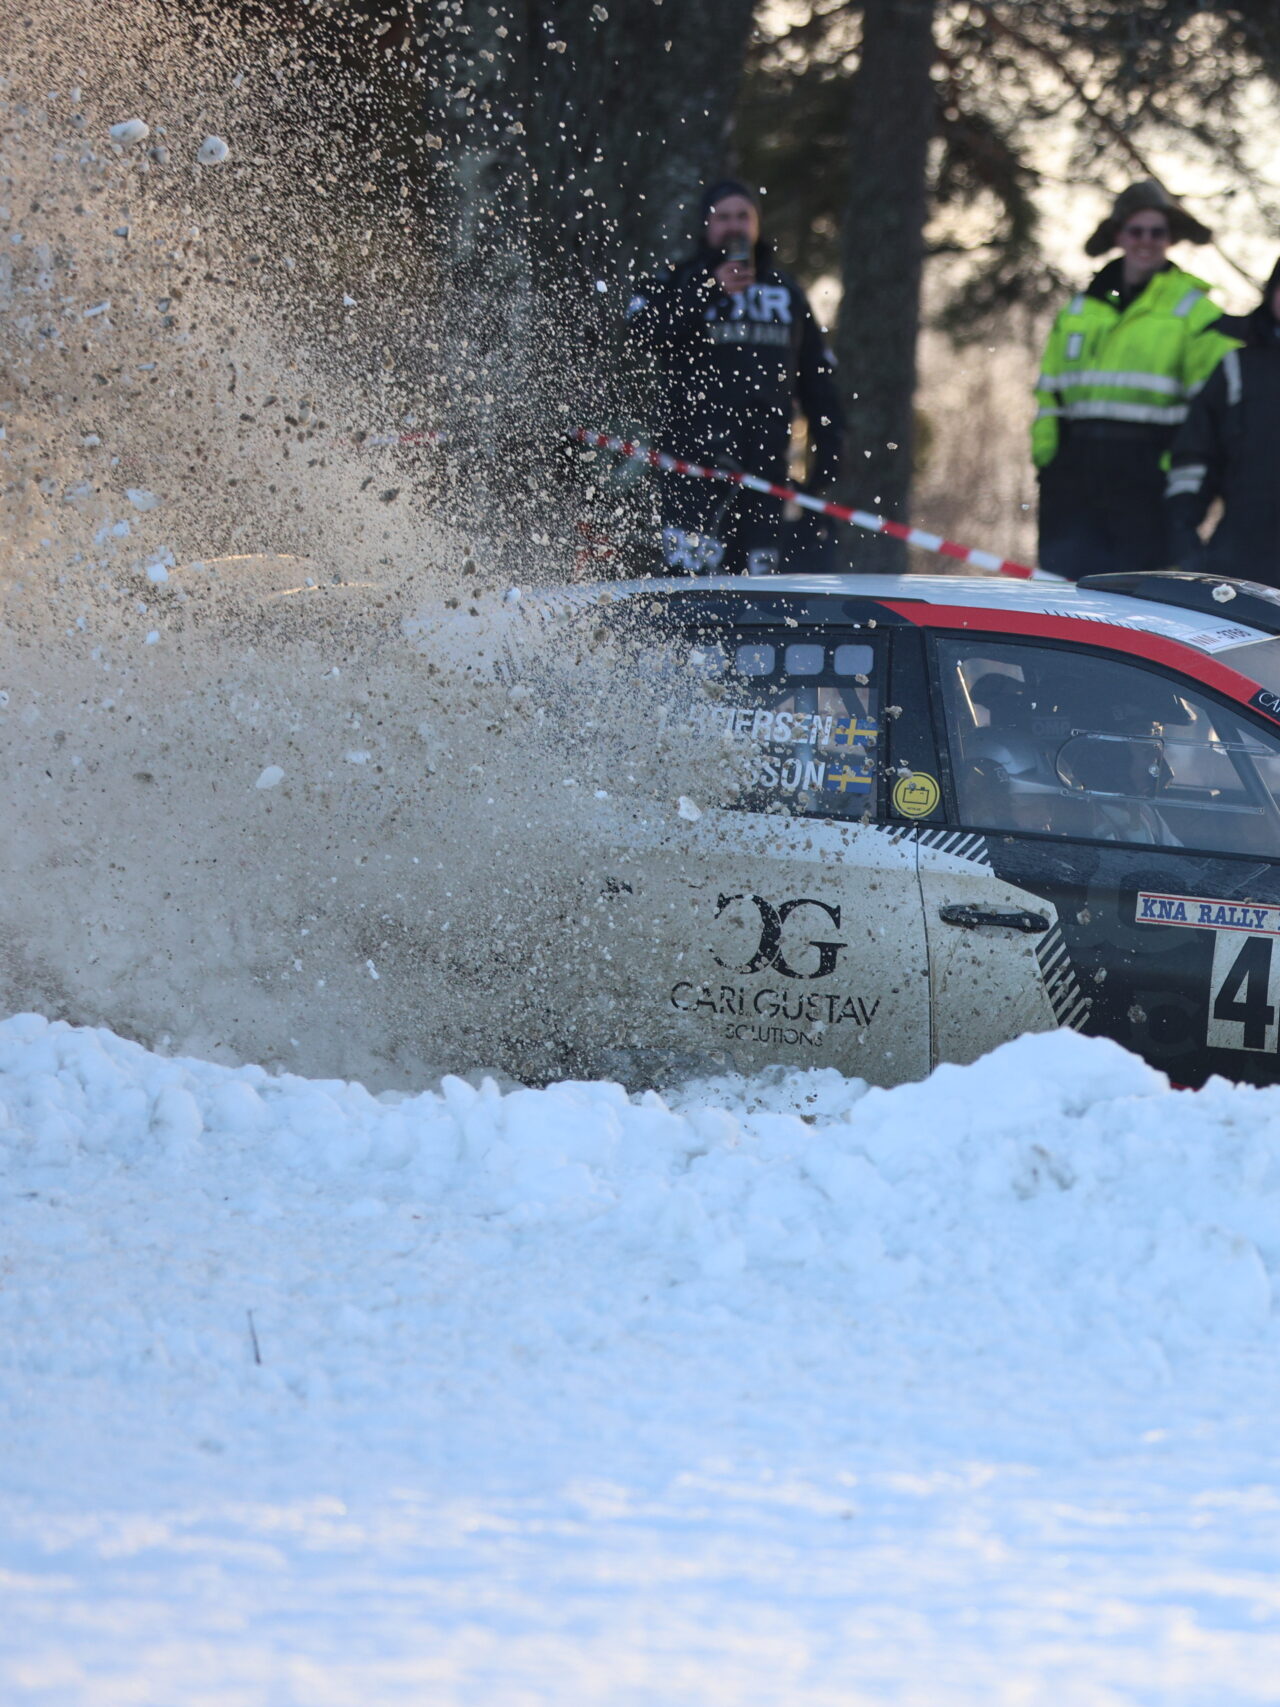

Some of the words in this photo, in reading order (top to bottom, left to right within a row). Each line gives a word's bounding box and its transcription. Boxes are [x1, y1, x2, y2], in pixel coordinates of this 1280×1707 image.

[703, 284, 792, 323] XR
[1140, 898, 1188, 922] KNA
[1197, 904, 1268, 929] RALLY
[753, 988, 880, 1027] GUSTAV
[1213, 936, 1275, 1050] 4
